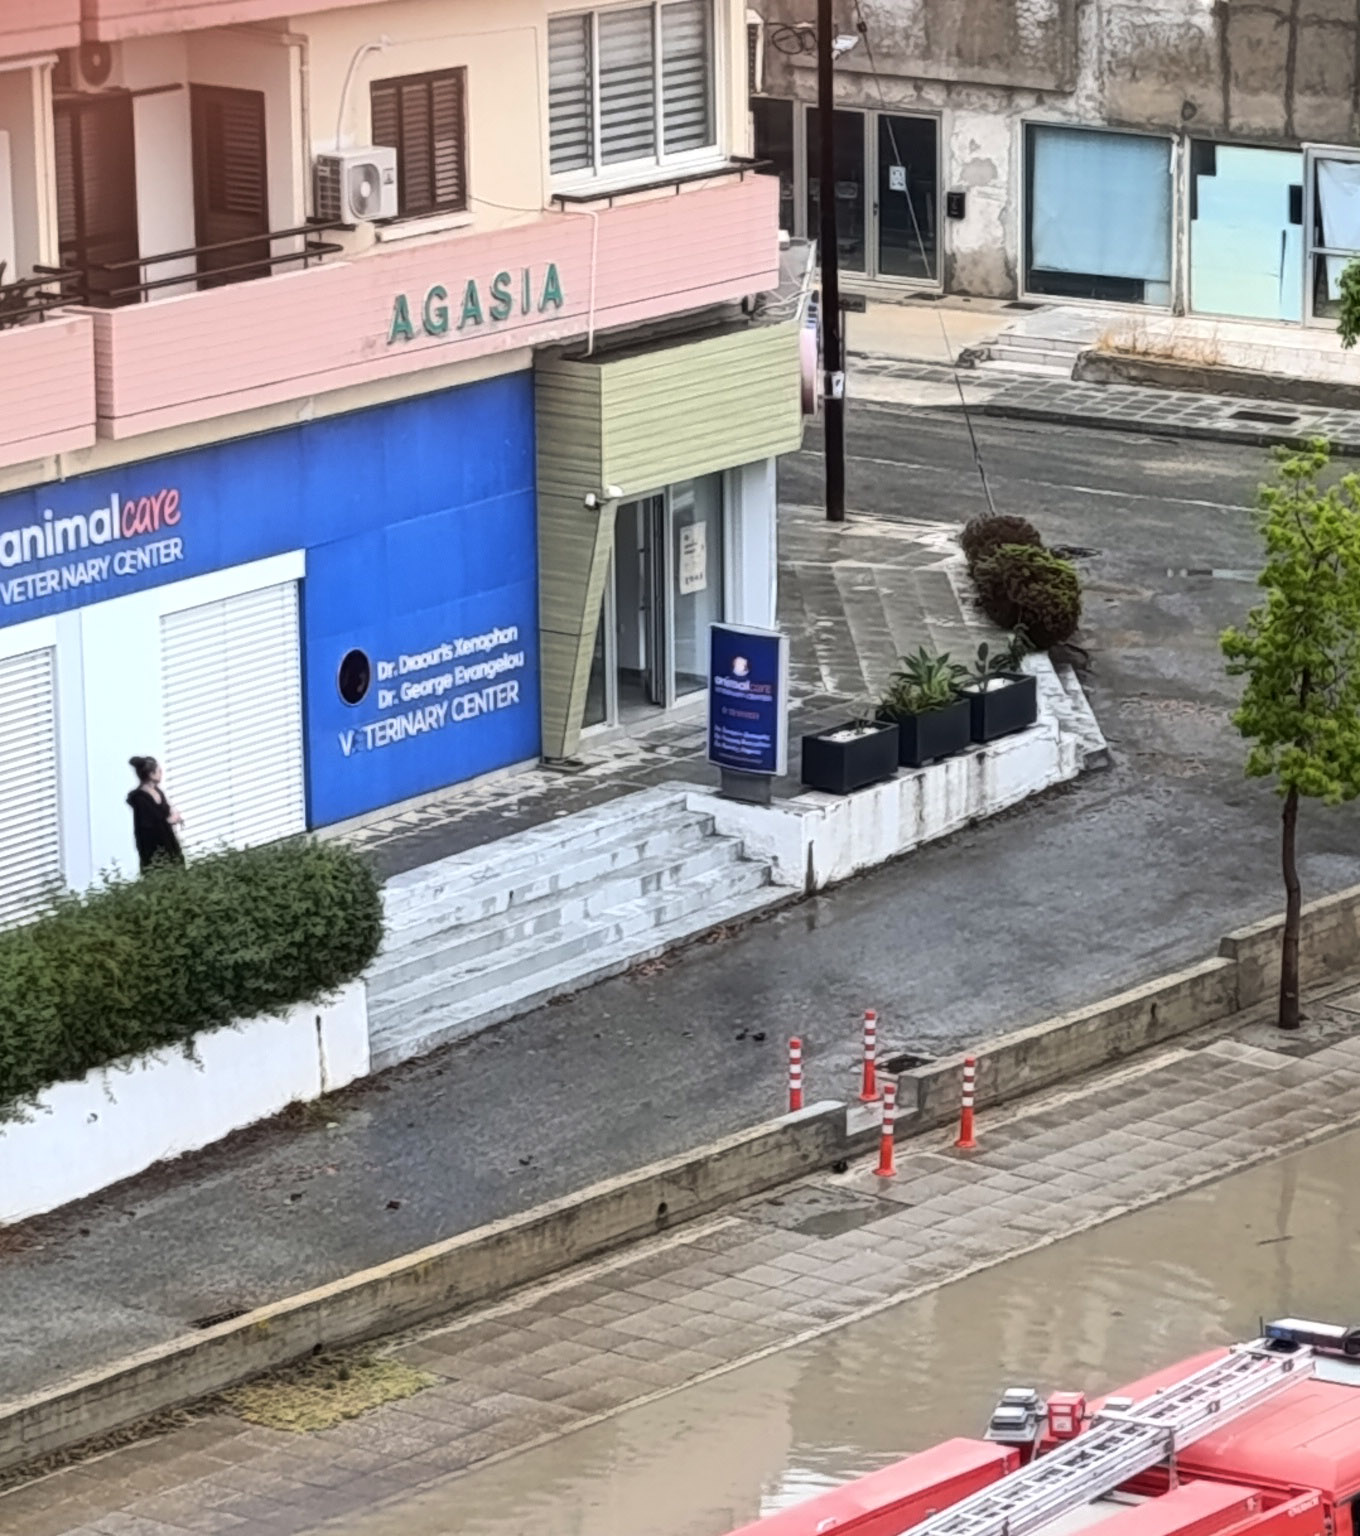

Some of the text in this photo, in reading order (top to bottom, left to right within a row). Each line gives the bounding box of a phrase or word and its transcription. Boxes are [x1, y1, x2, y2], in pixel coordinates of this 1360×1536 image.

[386, 262, 564, 345] AGASIA
[0, 488, 181, 567] animalcare
[0, 537, 184, 605] VETERNARY CENTER
[377, 661, 399, 681] Dr.
[453, 626, 518, 658] Xenophon
[379, 651, 524, 710] Dr. George Evangelou
[338, 680, 520, 757] VTERINARY CENTER
